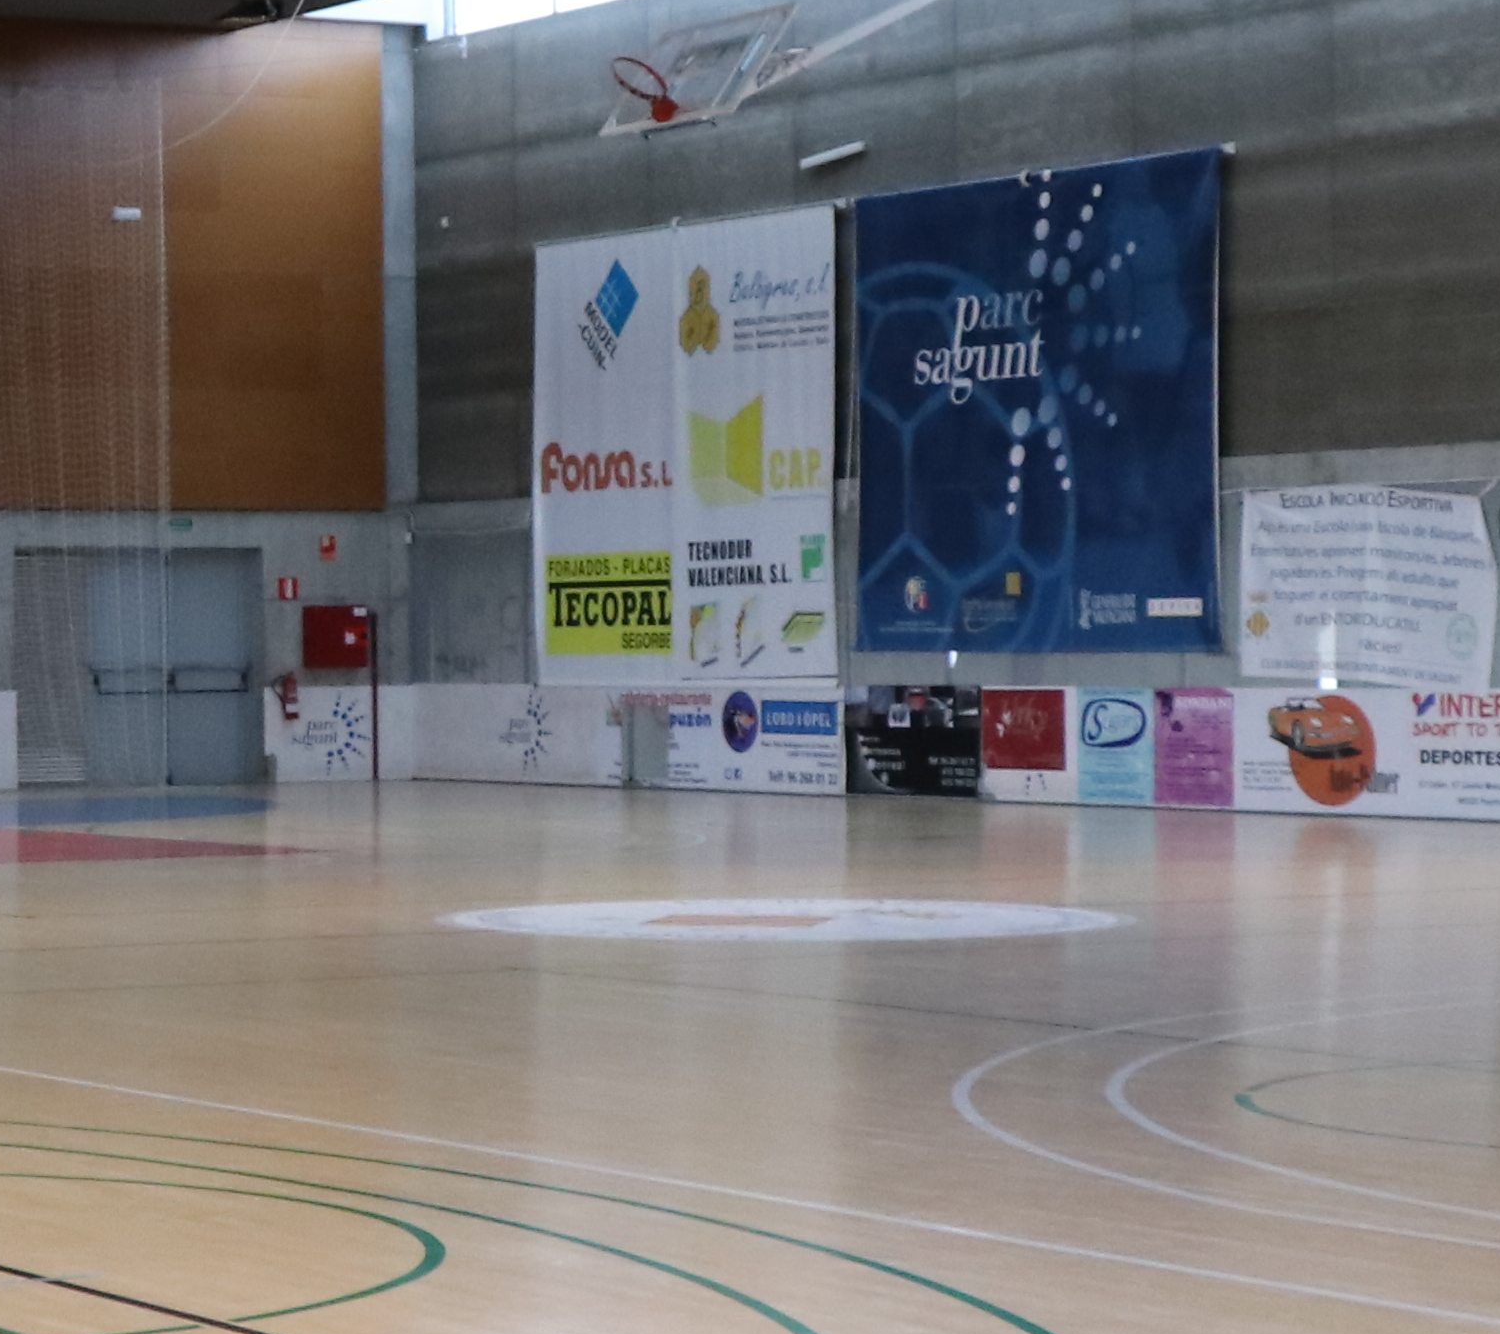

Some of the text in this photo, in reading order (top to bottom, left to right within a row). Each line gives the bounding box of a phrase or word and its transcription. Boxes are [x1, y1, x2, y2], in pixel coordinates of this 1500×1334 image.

[584, 301, 618, 360] MODEL
[951, 289, 1043, 355] parc
[914, 328, 1045, 404] sagunt
[769, 448, 822, 490] CAP
[688, 539, 753, 561] TECNODUR
[549, 558, 612, 577] FORJADOS
[623, 556, 671, 575] PLACAS
[549, 579, 672, 628] TECOPAL
[622, 631, 671, 650] SEGORBE
[766, 711, 796, 726] LOBO
[1412, 721, 1461, 737] SPORT
[1467, 722, 1487, 737] TO
